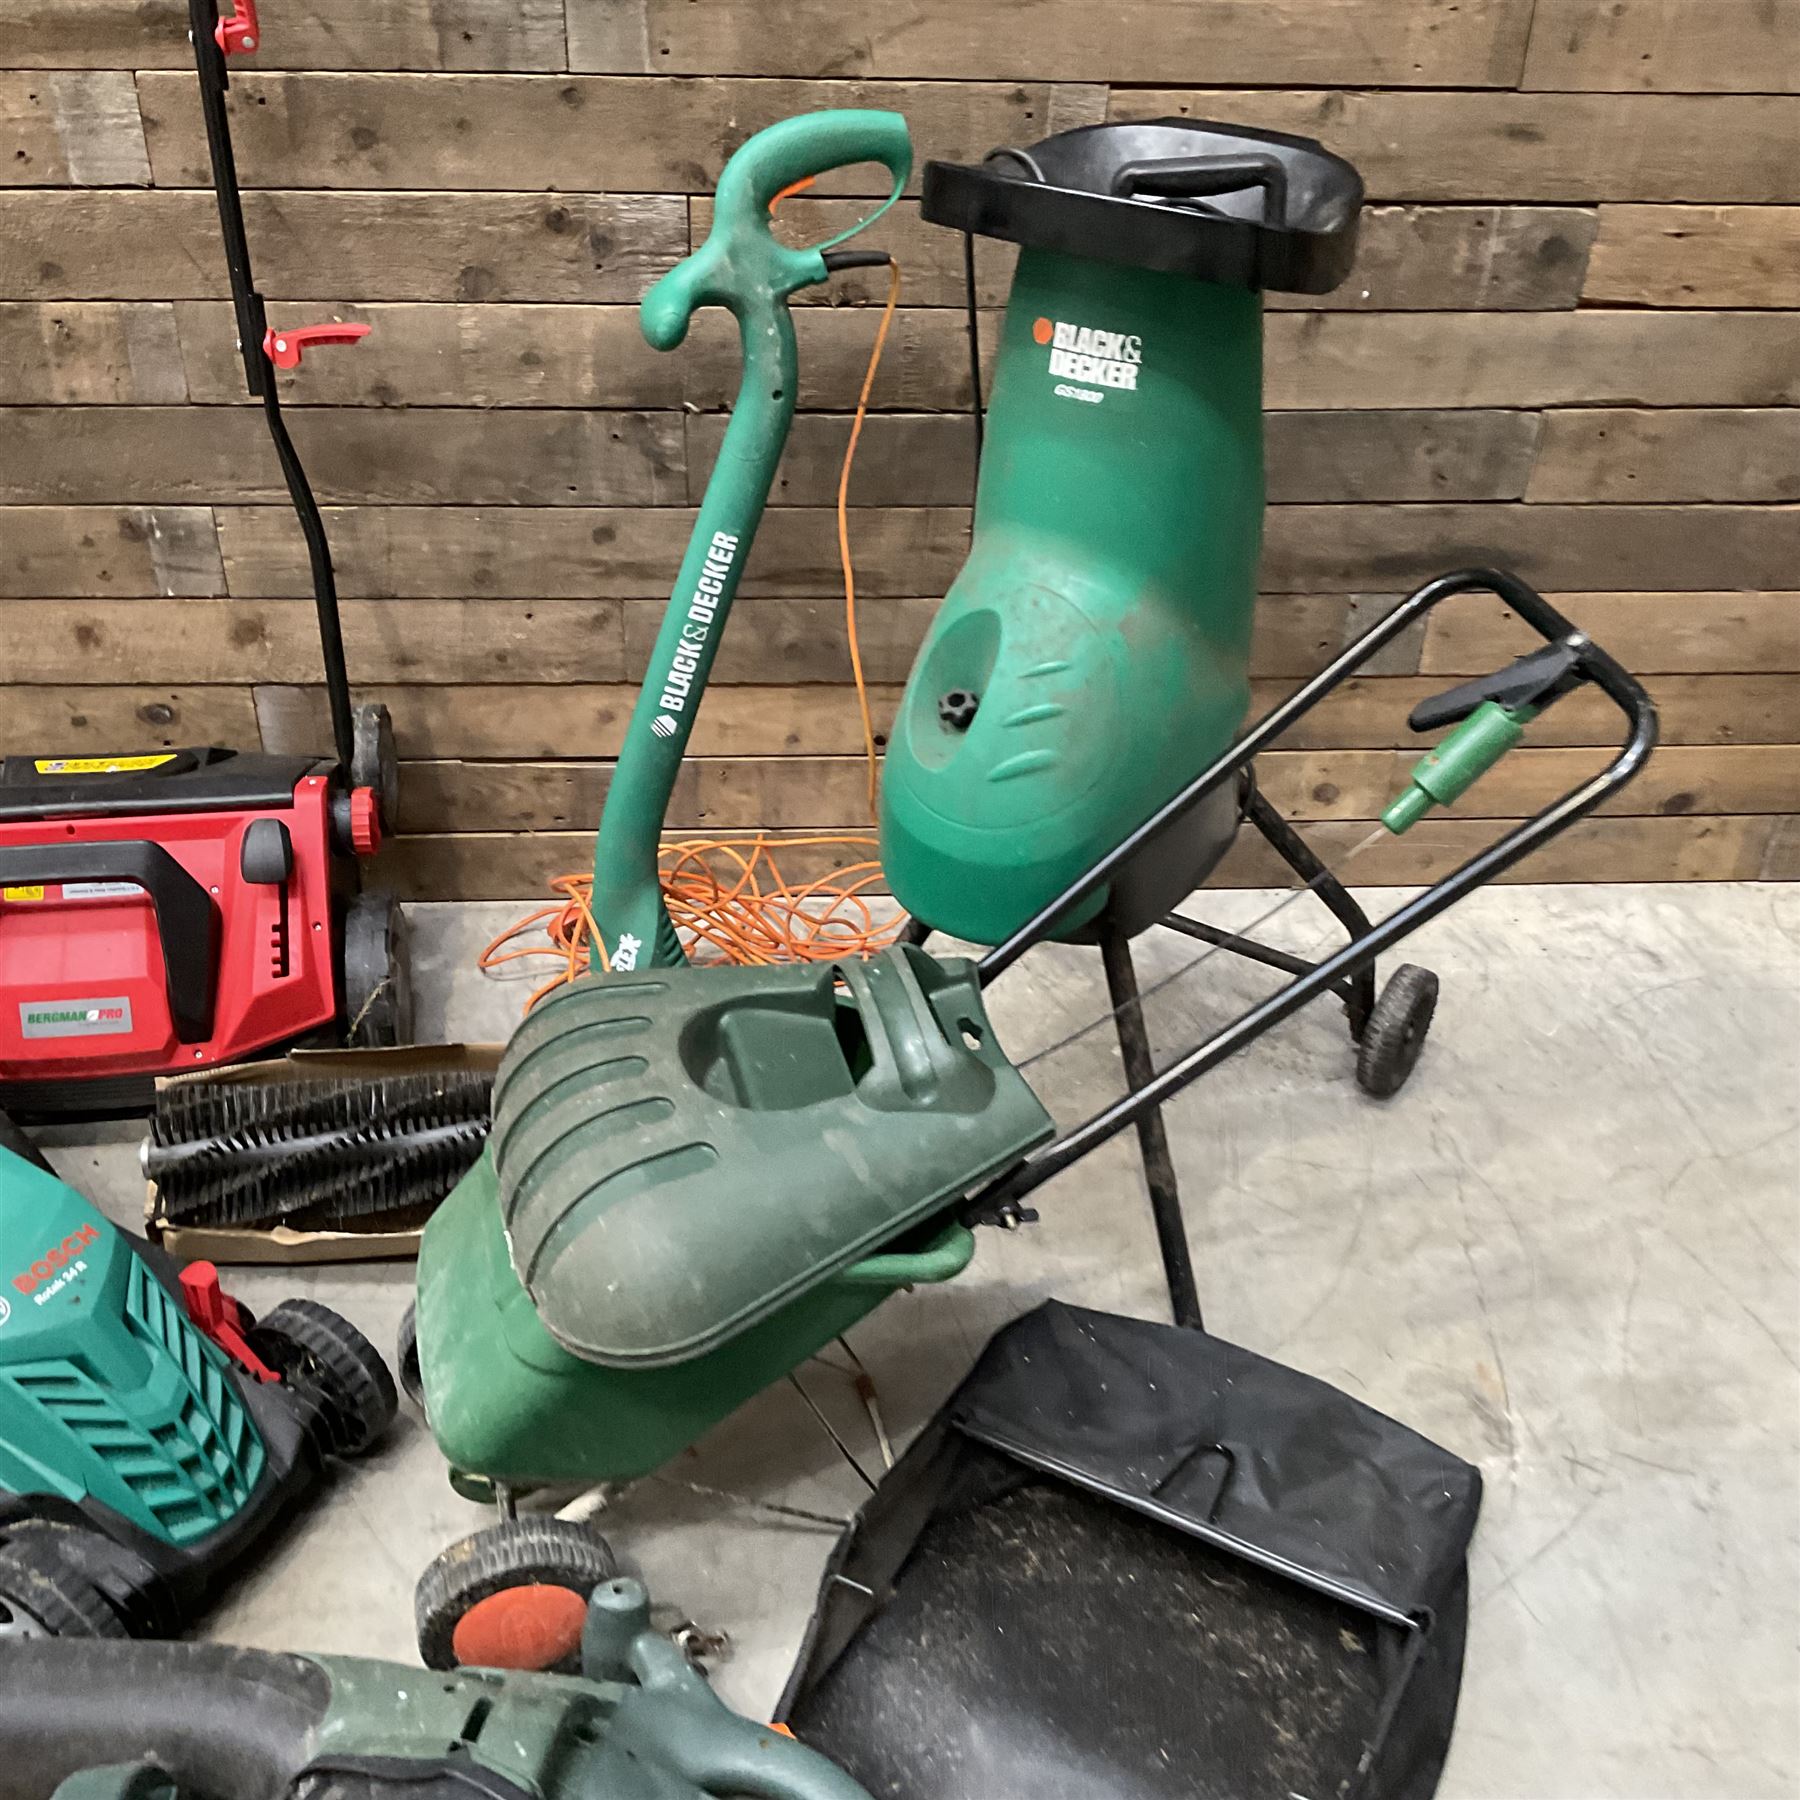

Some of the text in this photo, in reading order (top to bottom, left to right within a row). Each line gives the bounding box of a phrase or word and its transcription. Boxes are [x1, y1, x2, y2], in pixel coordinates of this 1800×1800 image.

[1048, 348, 1139, 390] DECKER
[27, 1010, 88, 1025] BERGMAN
[98, 1007, 123, 1020] PRO
[11, 1222, 101, 1296] BOSCH
